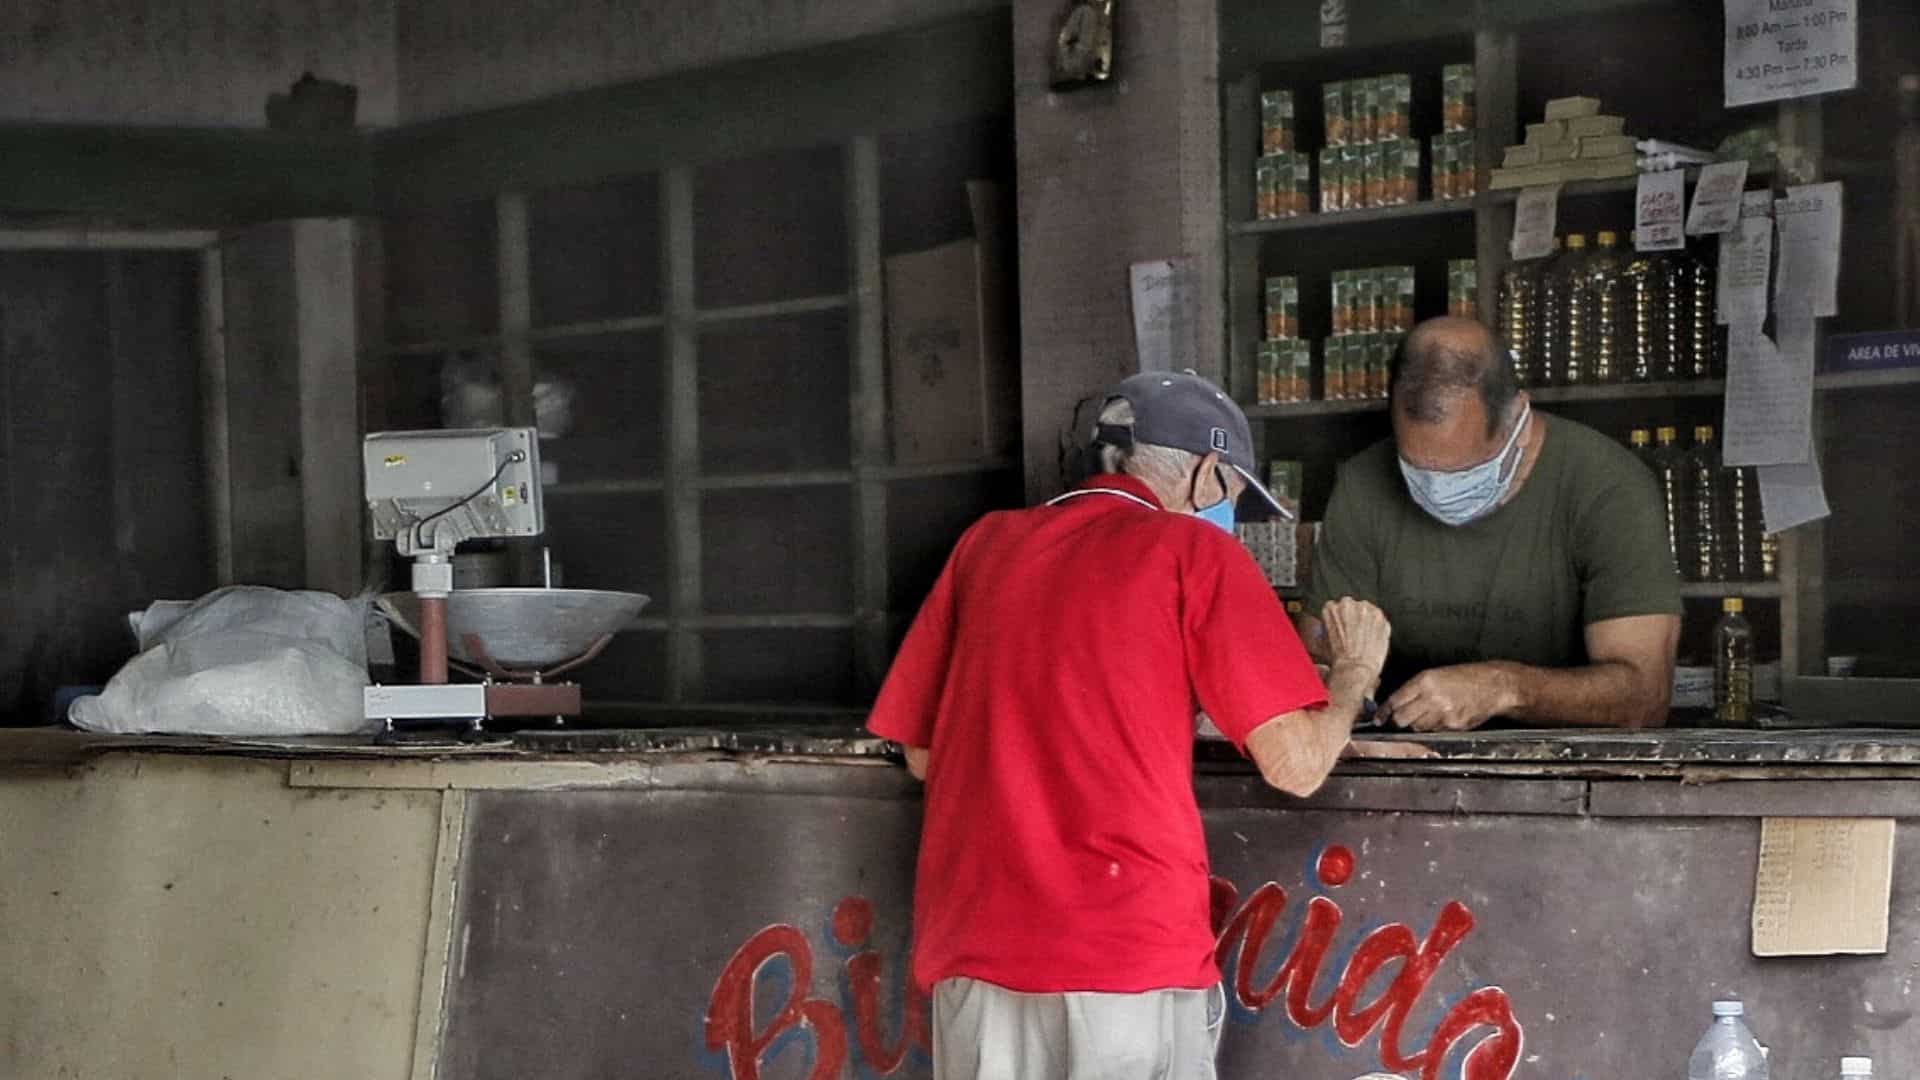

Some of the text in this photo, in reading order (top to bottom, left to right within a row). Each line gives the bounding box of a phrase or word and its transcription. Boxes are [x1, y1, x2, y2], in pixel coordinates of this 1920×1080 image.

[1776, 38, 1808, 54] Tarde
[1848, 345, 1880, 360] AREA
[1884, 343, 1899, 359] DE
